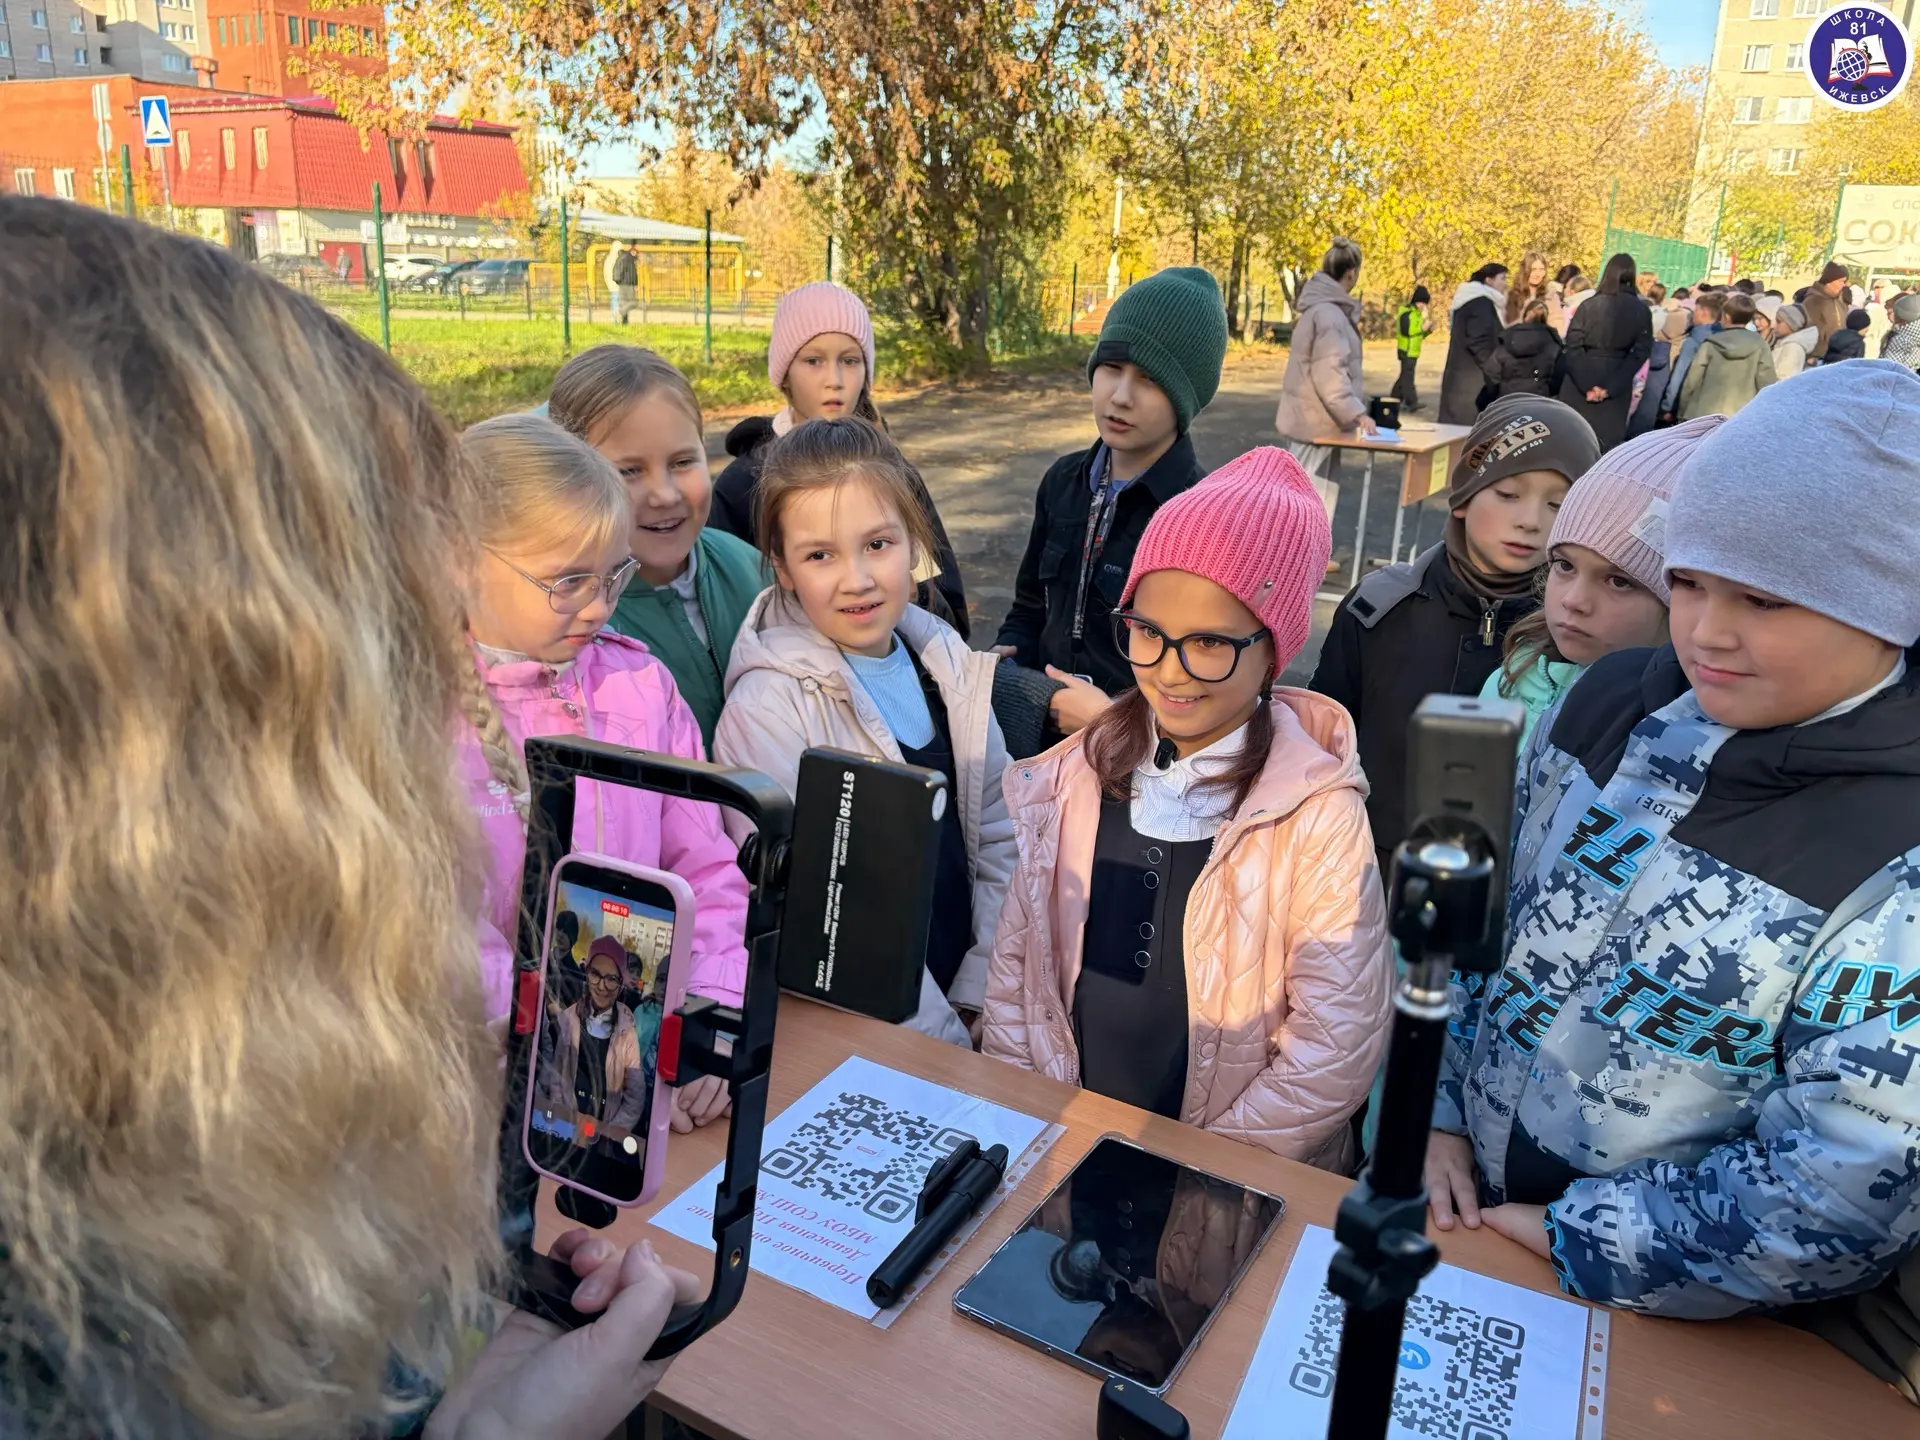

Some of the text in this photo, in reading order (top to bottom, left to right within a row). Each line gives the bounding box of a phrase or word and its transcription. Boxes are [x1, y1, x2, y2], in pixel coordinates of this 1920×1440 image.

[840, 771, 855, 817] ST120
[770, 1198, 819, 1220] СОШ
[778, 1221, 872, 1262] Движения
[817, 1218, 878, 1244] МБОУ
[772, 1241, 864, 1285] Первичное
